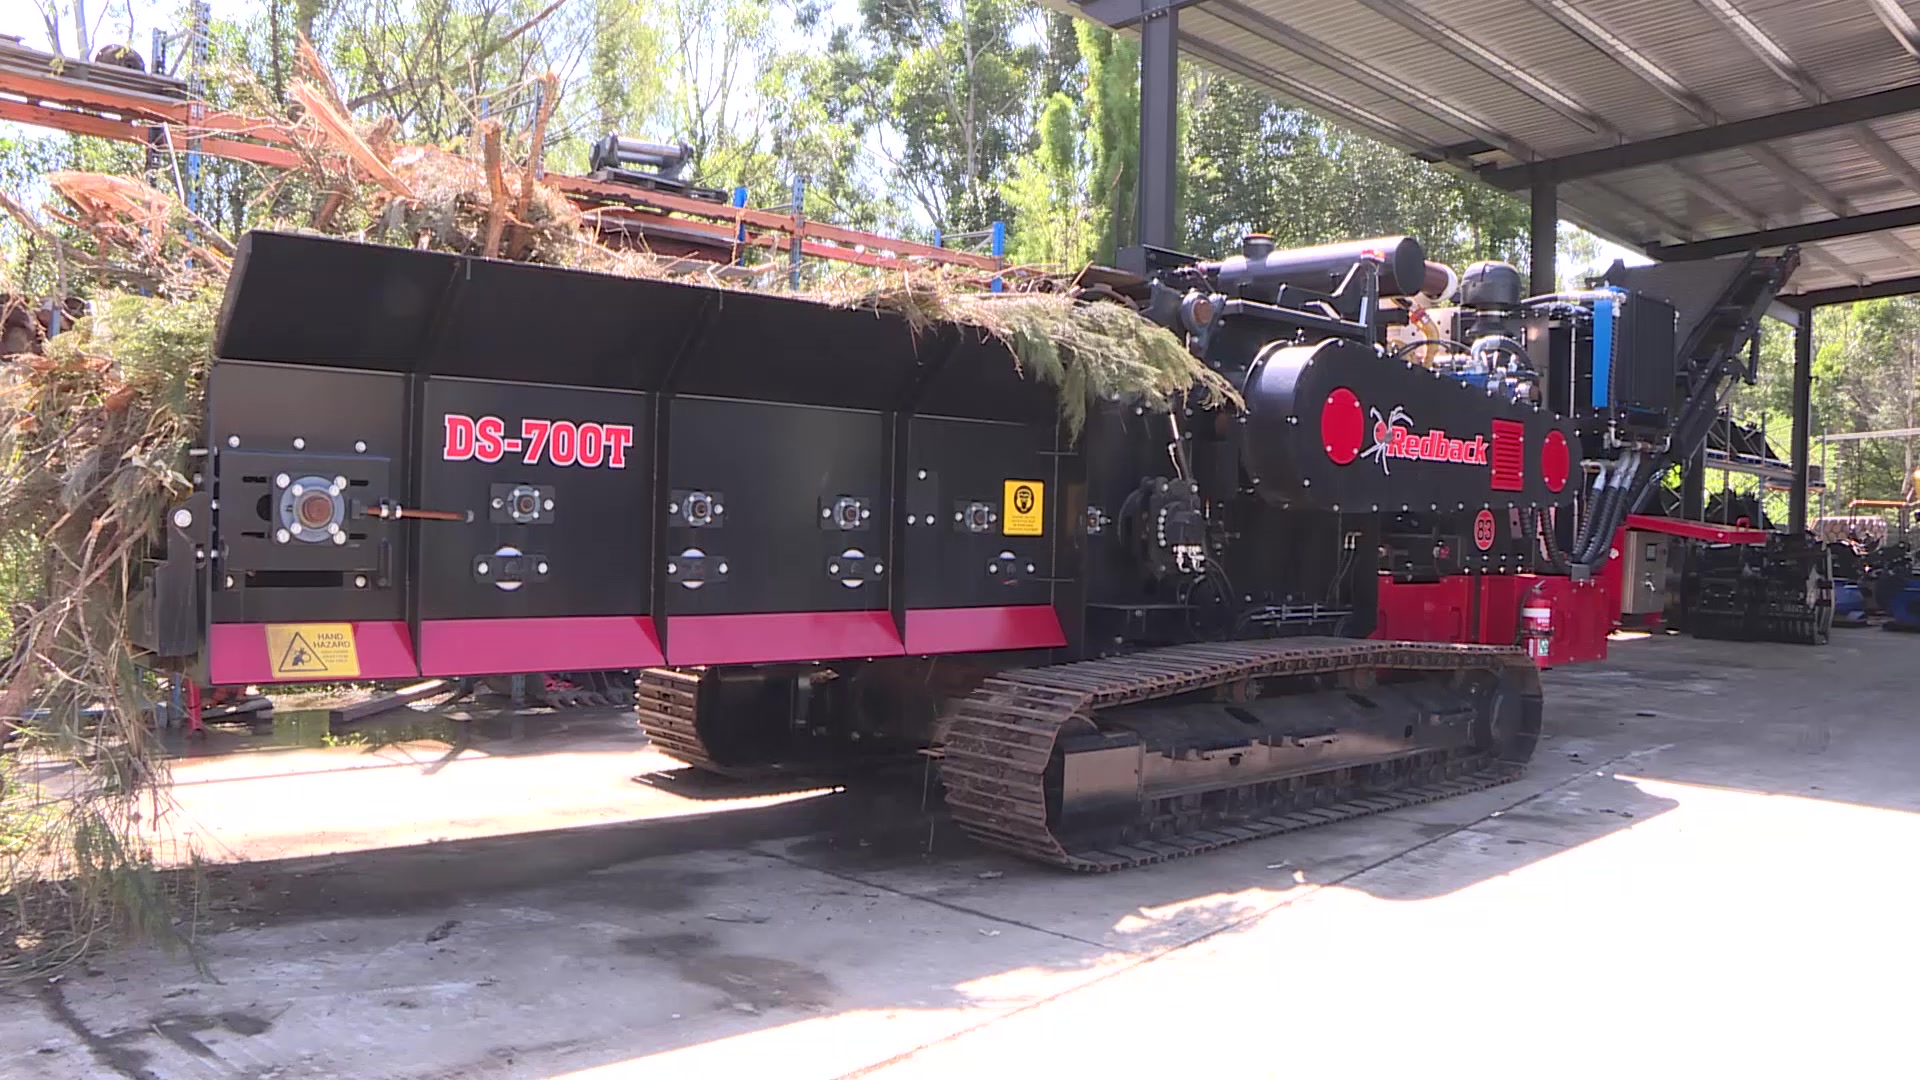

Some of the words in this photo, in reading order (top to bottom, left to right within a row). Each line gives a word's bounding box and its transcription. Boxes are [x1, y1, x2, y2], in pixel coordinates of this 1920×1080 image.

[443, 413, 634, 468] DS-700T
[1386, 425, 1489, 465] Redback
[1478, 519, 1492, 540] 83
[312, 640, 351, 649] HAZARD
[317, 632, 344, 641] HAND
